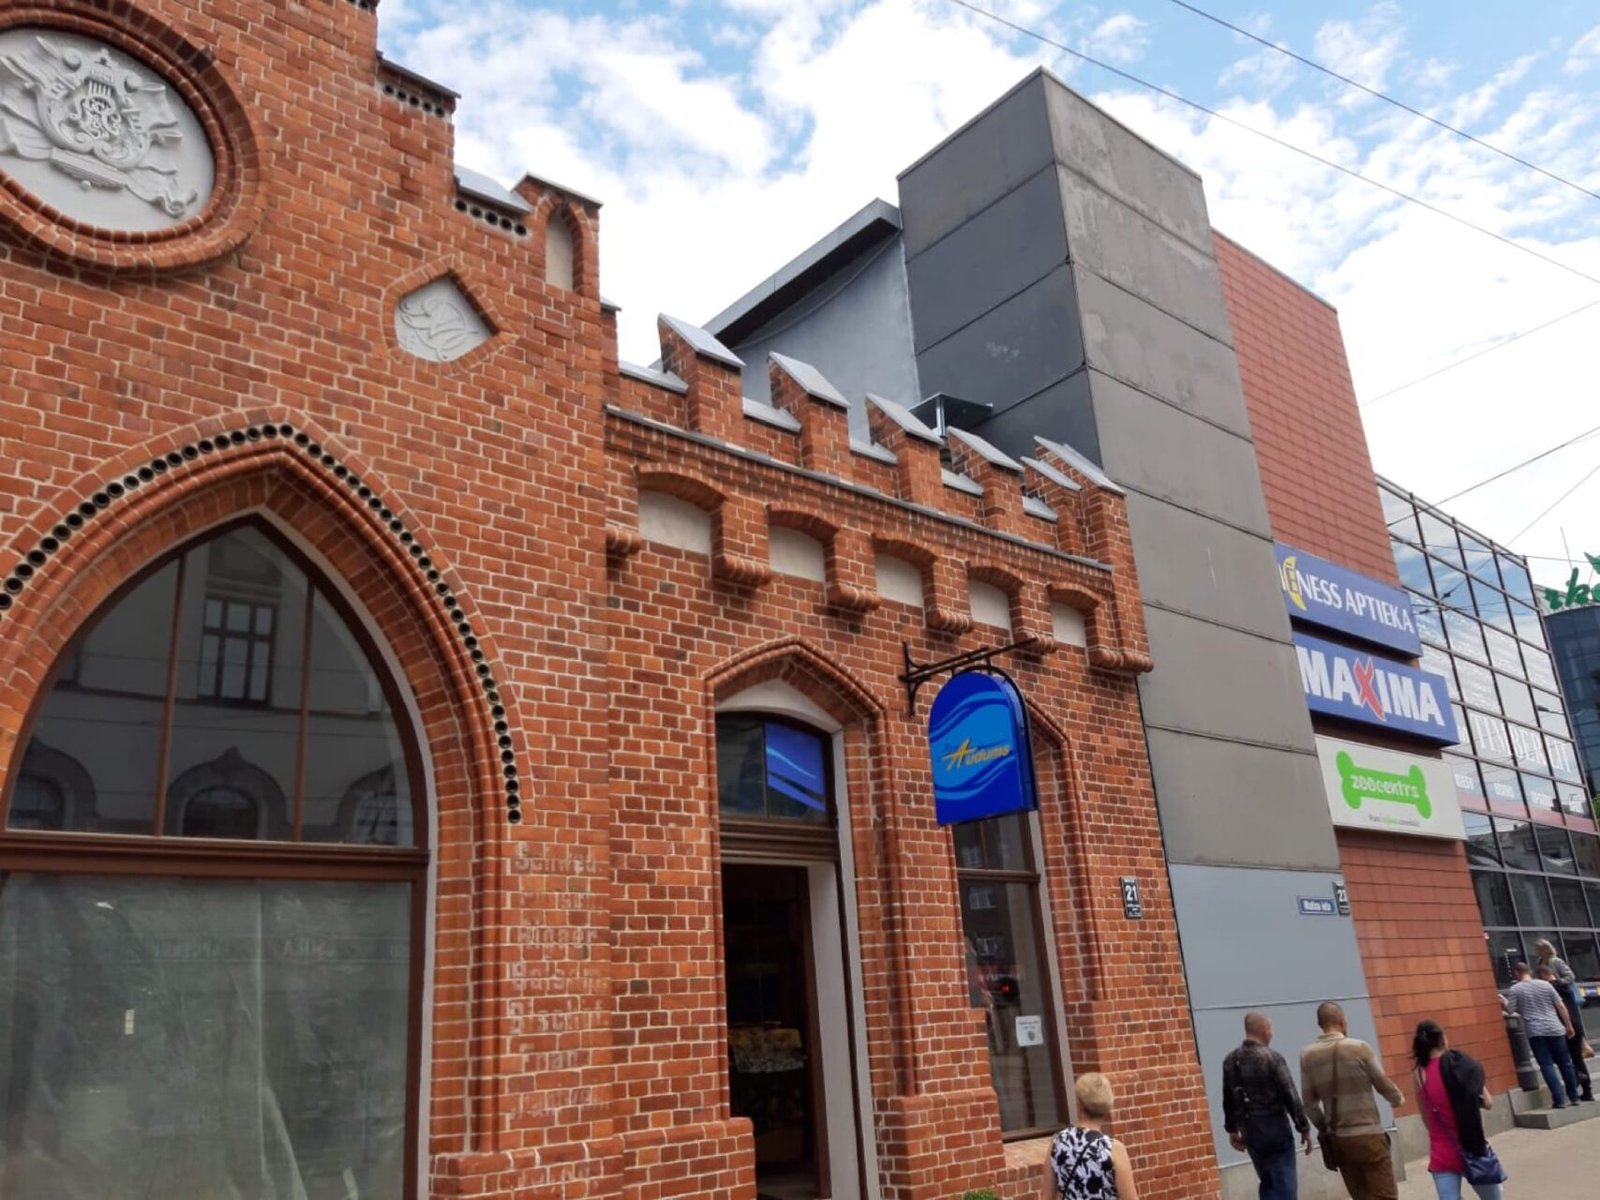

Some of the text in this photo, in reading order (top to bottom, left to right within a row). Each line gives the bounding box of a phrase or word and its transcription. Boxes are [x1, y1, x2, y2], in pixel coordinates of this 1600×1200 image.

[1345, 588, 1415, 634] APTIEKA
[1296, 646, 1445, 722] MAXIMA
[1350, 775, 1419, 798] zoocentrs
[1125, 885, 1138, 901] 21
